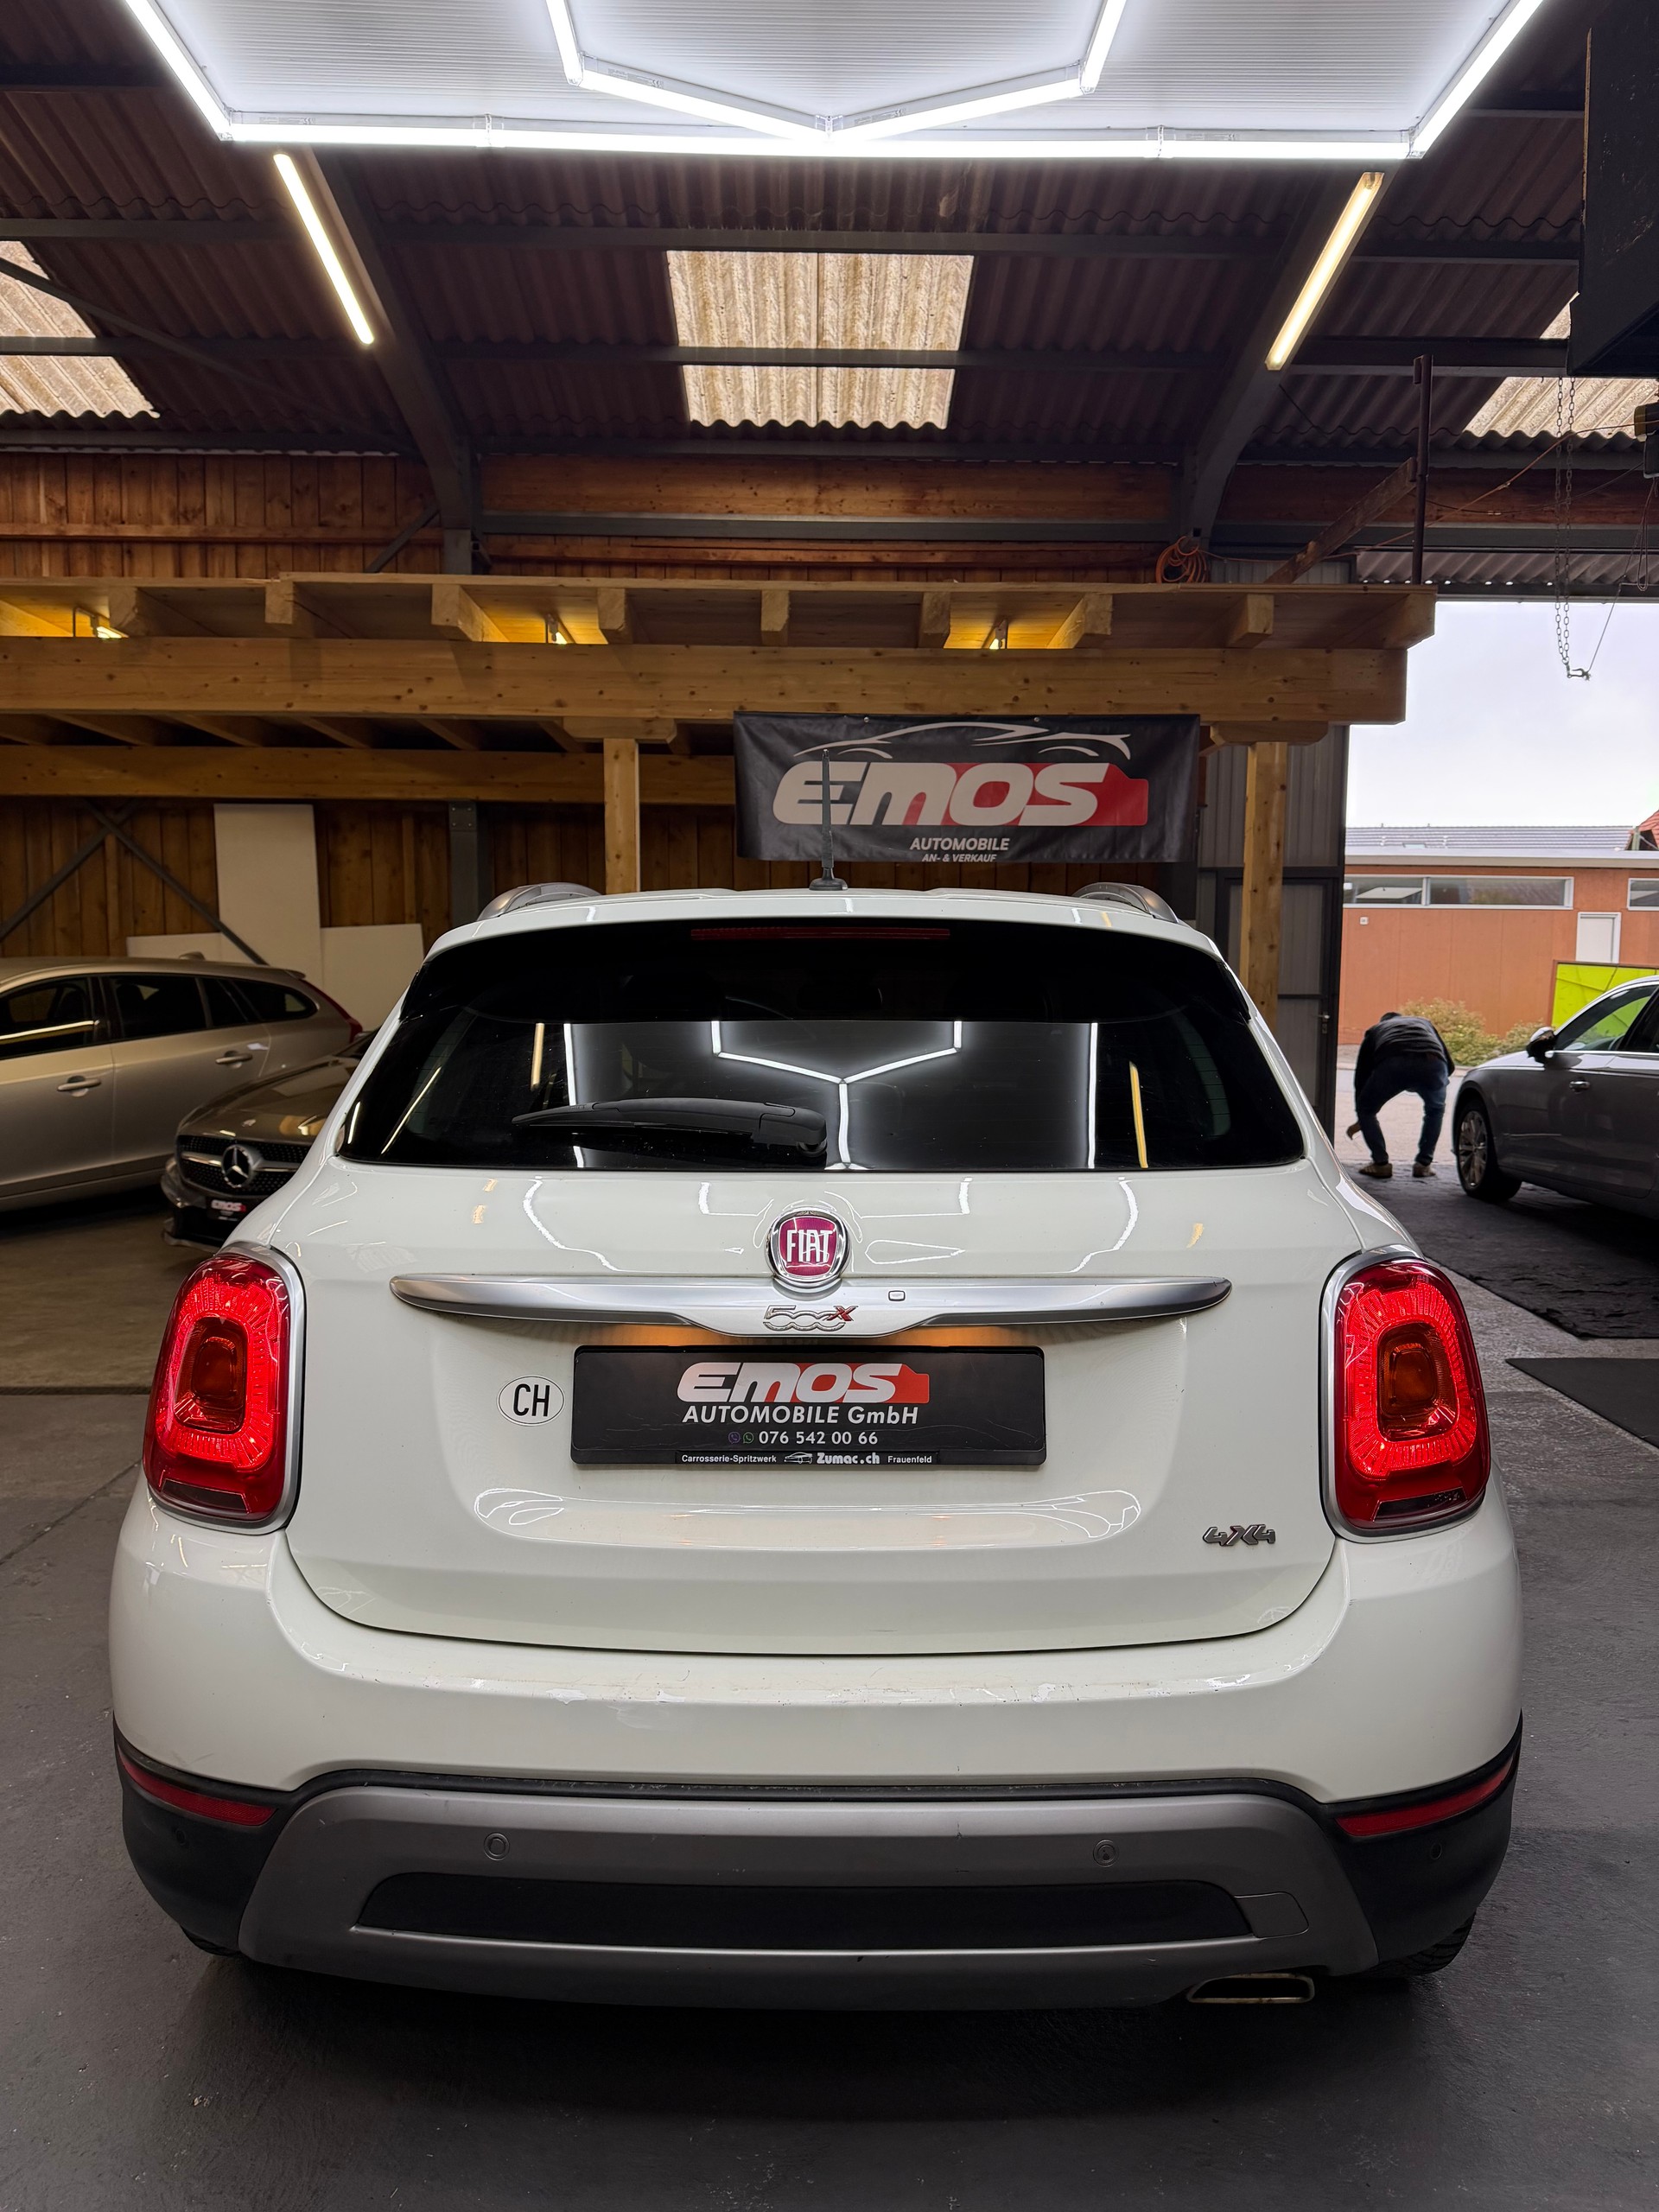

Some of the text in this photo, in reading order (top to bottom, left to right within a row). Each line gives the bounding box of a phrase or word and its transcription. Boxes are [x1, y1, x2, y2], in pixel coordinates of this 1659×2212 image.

[909, 837, 1010, 850] AUTOMOBILE
[921, 854, 997, 862] AN- & VERKAUF
[786, 1229, 834, 1263] FIAT
[512, 1383, 550, 1417] CH
[682, 1405, 918, 1425] AUTOMOBILE GmbH
[759, 1431, 878, 1445] 076 542 00 66
[681, 1452, 932, 1465] Carrosserie-Spritzwerk Zumac.ch Frauenfeld
